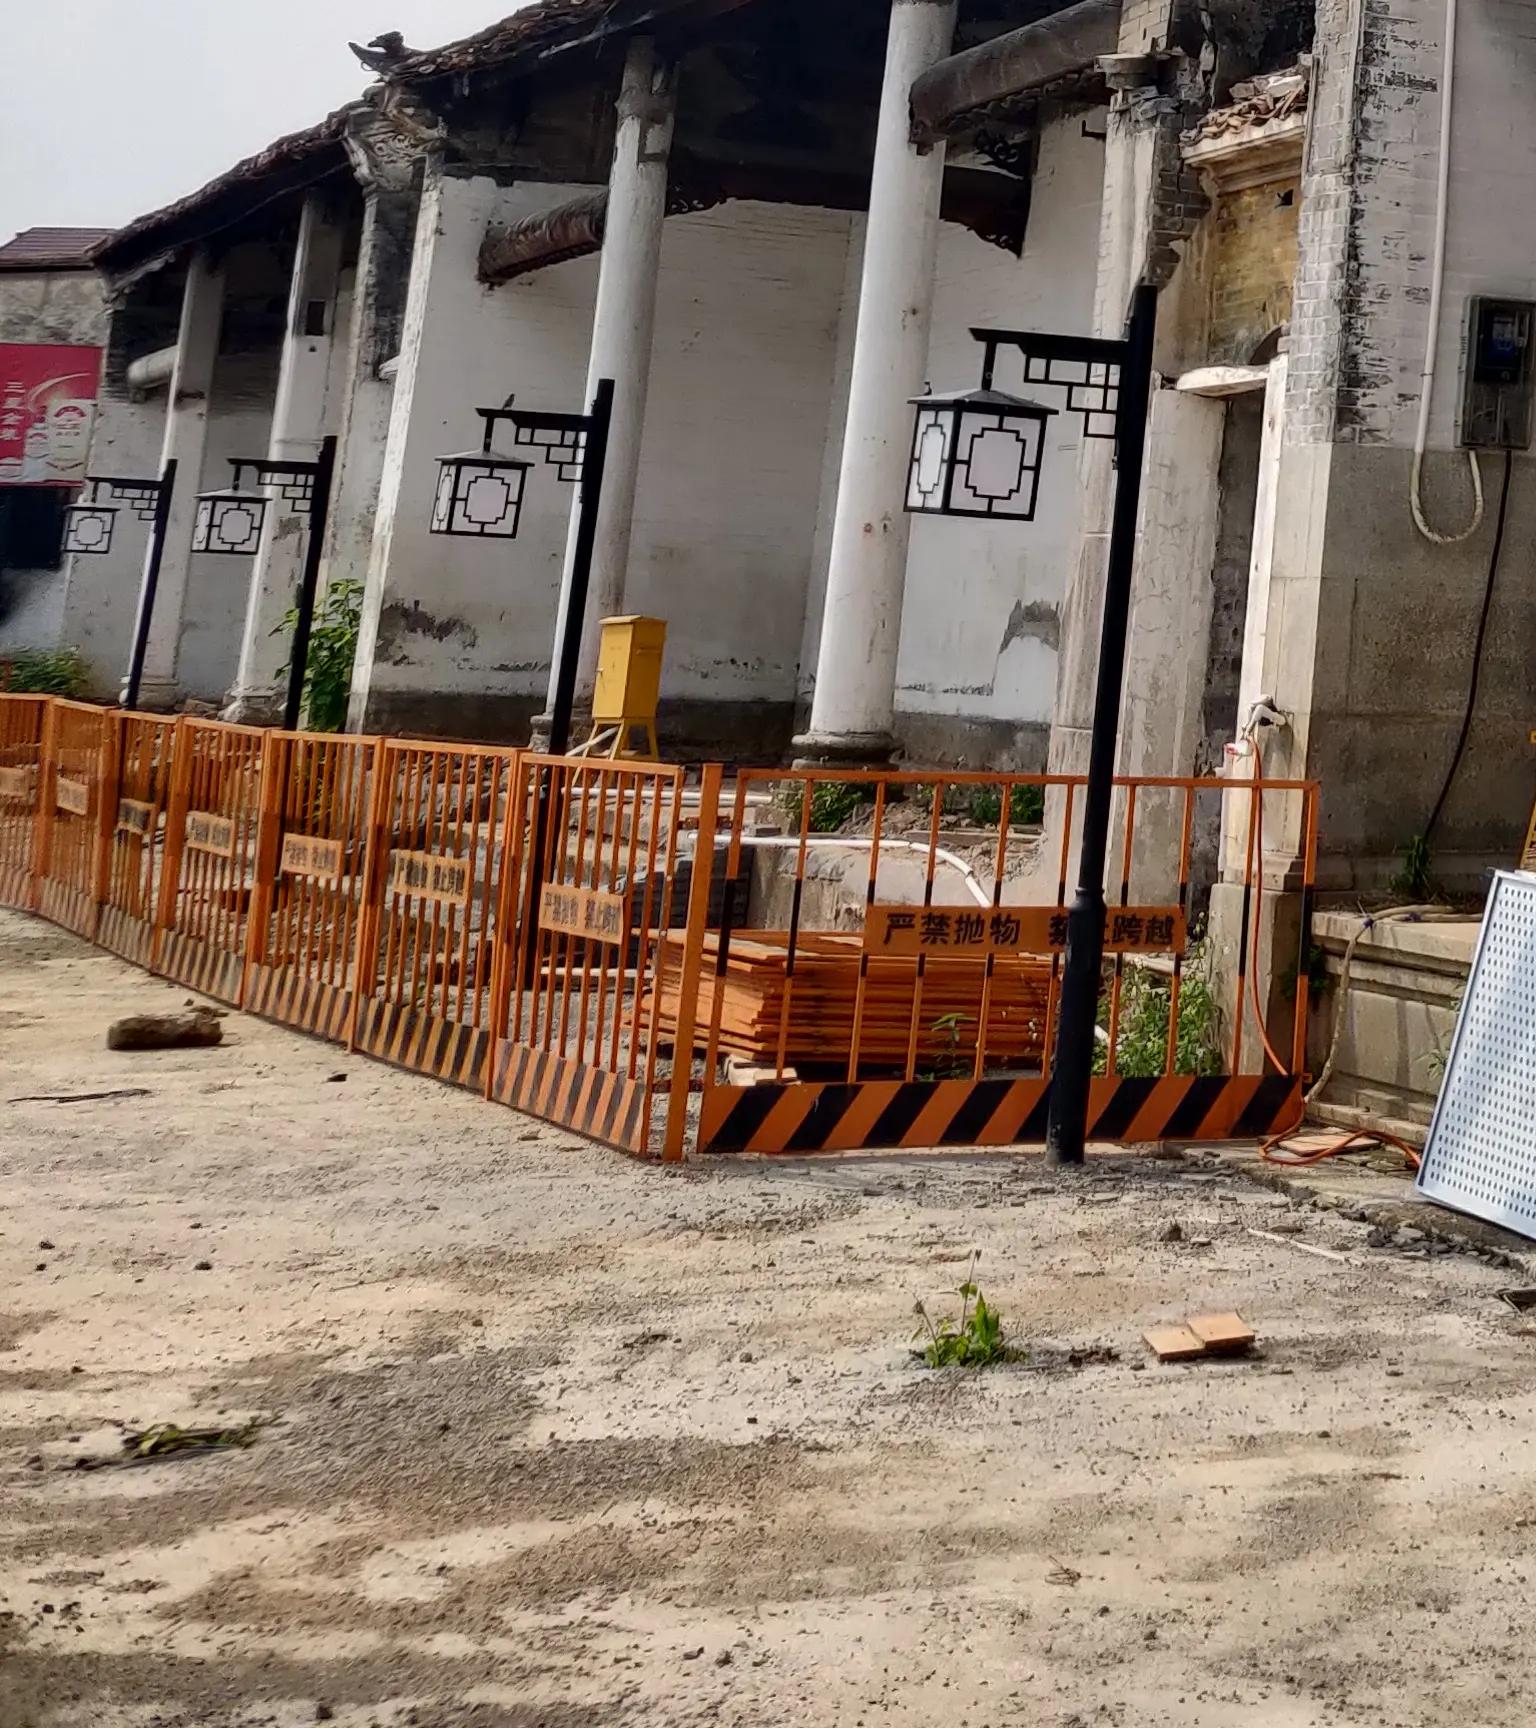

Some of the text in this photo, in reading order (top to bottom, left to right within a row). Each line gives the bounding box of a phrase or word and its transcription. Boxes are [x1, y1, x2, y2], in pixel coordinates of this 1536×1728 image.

[883, 912, 1176, 945] 严禁抛物 禁跨越
